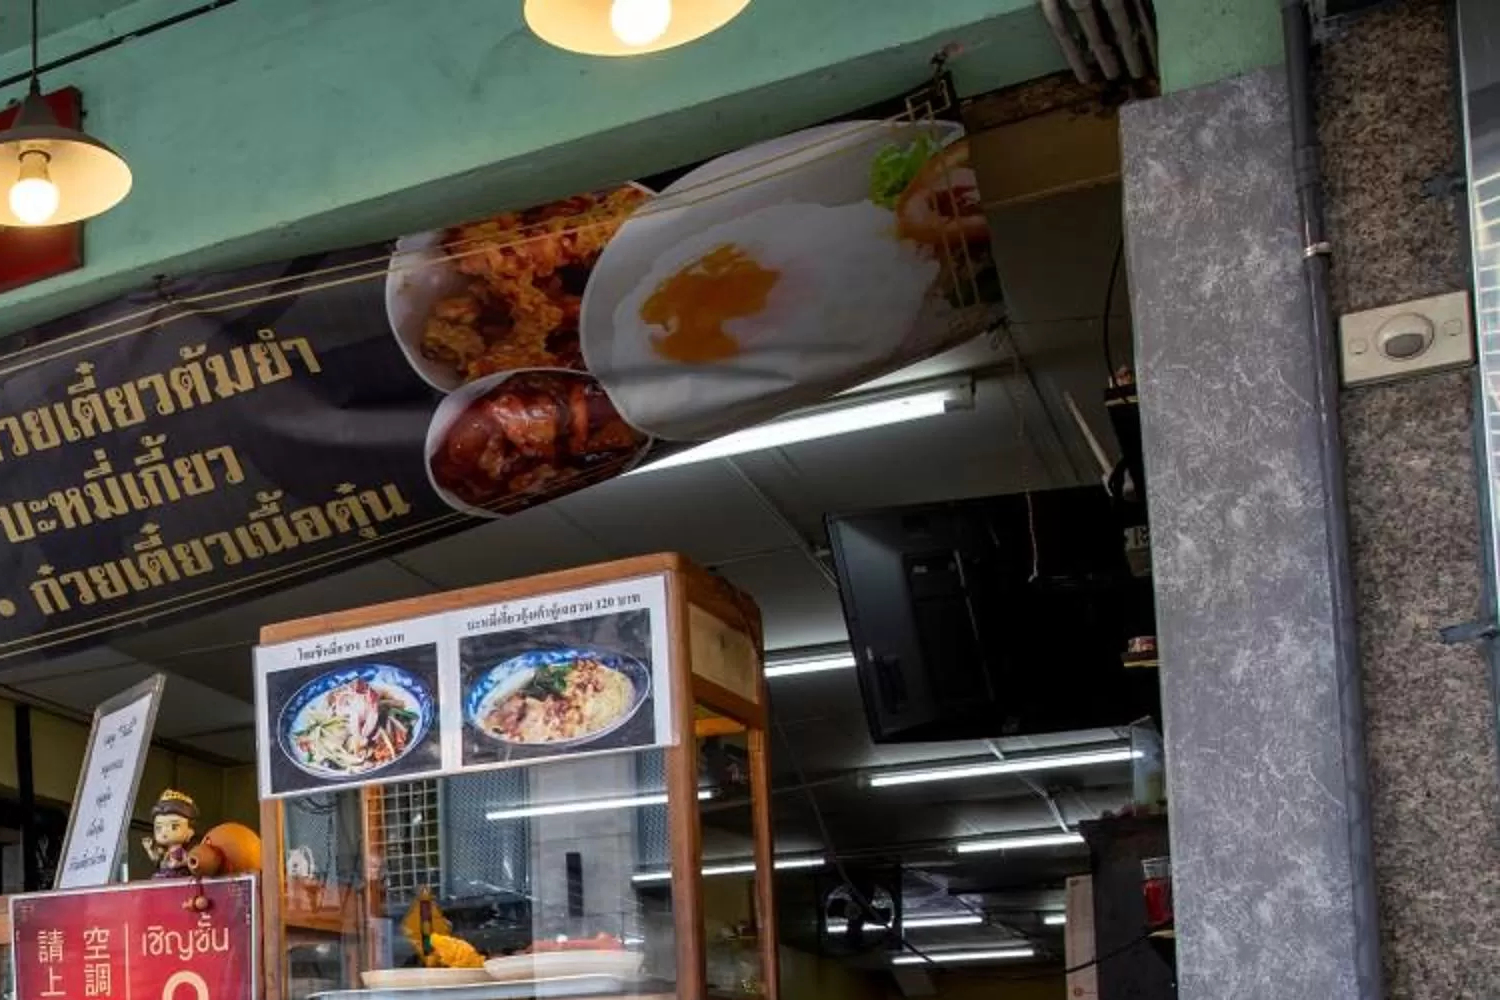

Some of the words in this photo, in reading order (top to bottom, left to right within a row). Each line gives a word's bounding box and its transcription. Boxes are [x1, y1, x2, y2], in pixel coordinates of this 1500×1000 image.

[29, 480, 412, 617] ก๋วยเตี๋ยวเนื้อตุ๋น
[595, 596, 615, 611] 120
[617, 593, 642, 608] บาท
[382, 633, 406, 646] บาท
[141, 914, 230, 962] เชิญชั้น
